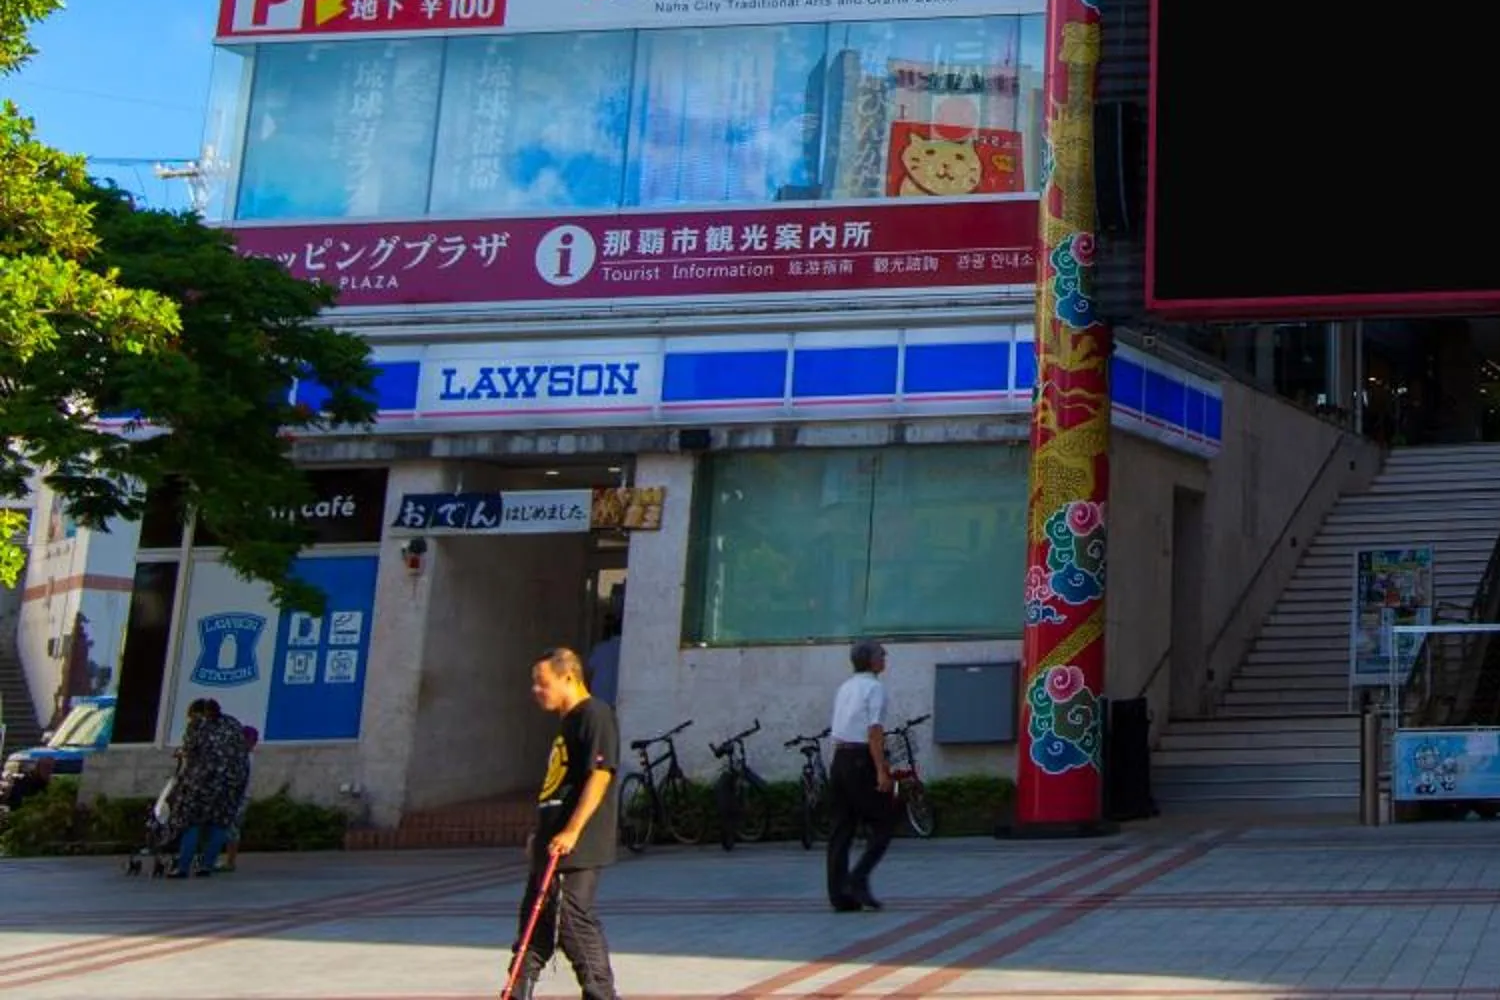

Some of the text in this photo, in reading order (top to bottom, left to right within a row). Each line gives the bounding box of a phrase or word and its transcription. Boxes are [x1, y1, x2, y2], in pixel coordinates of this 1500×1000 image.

[655, 1, 690, 13] Naha
[694, 0, 722, 14] City
[237, 232, 511, 271] ッピングプラザ
[602, 221, 873, 258] 那覇市観光案内所
[603, 266, 660, 282] Tourist
[672, 262, 774, 280] Information
[439, 361, 640, 401] LAWSON
[402, 500, 498, 528] おでん
